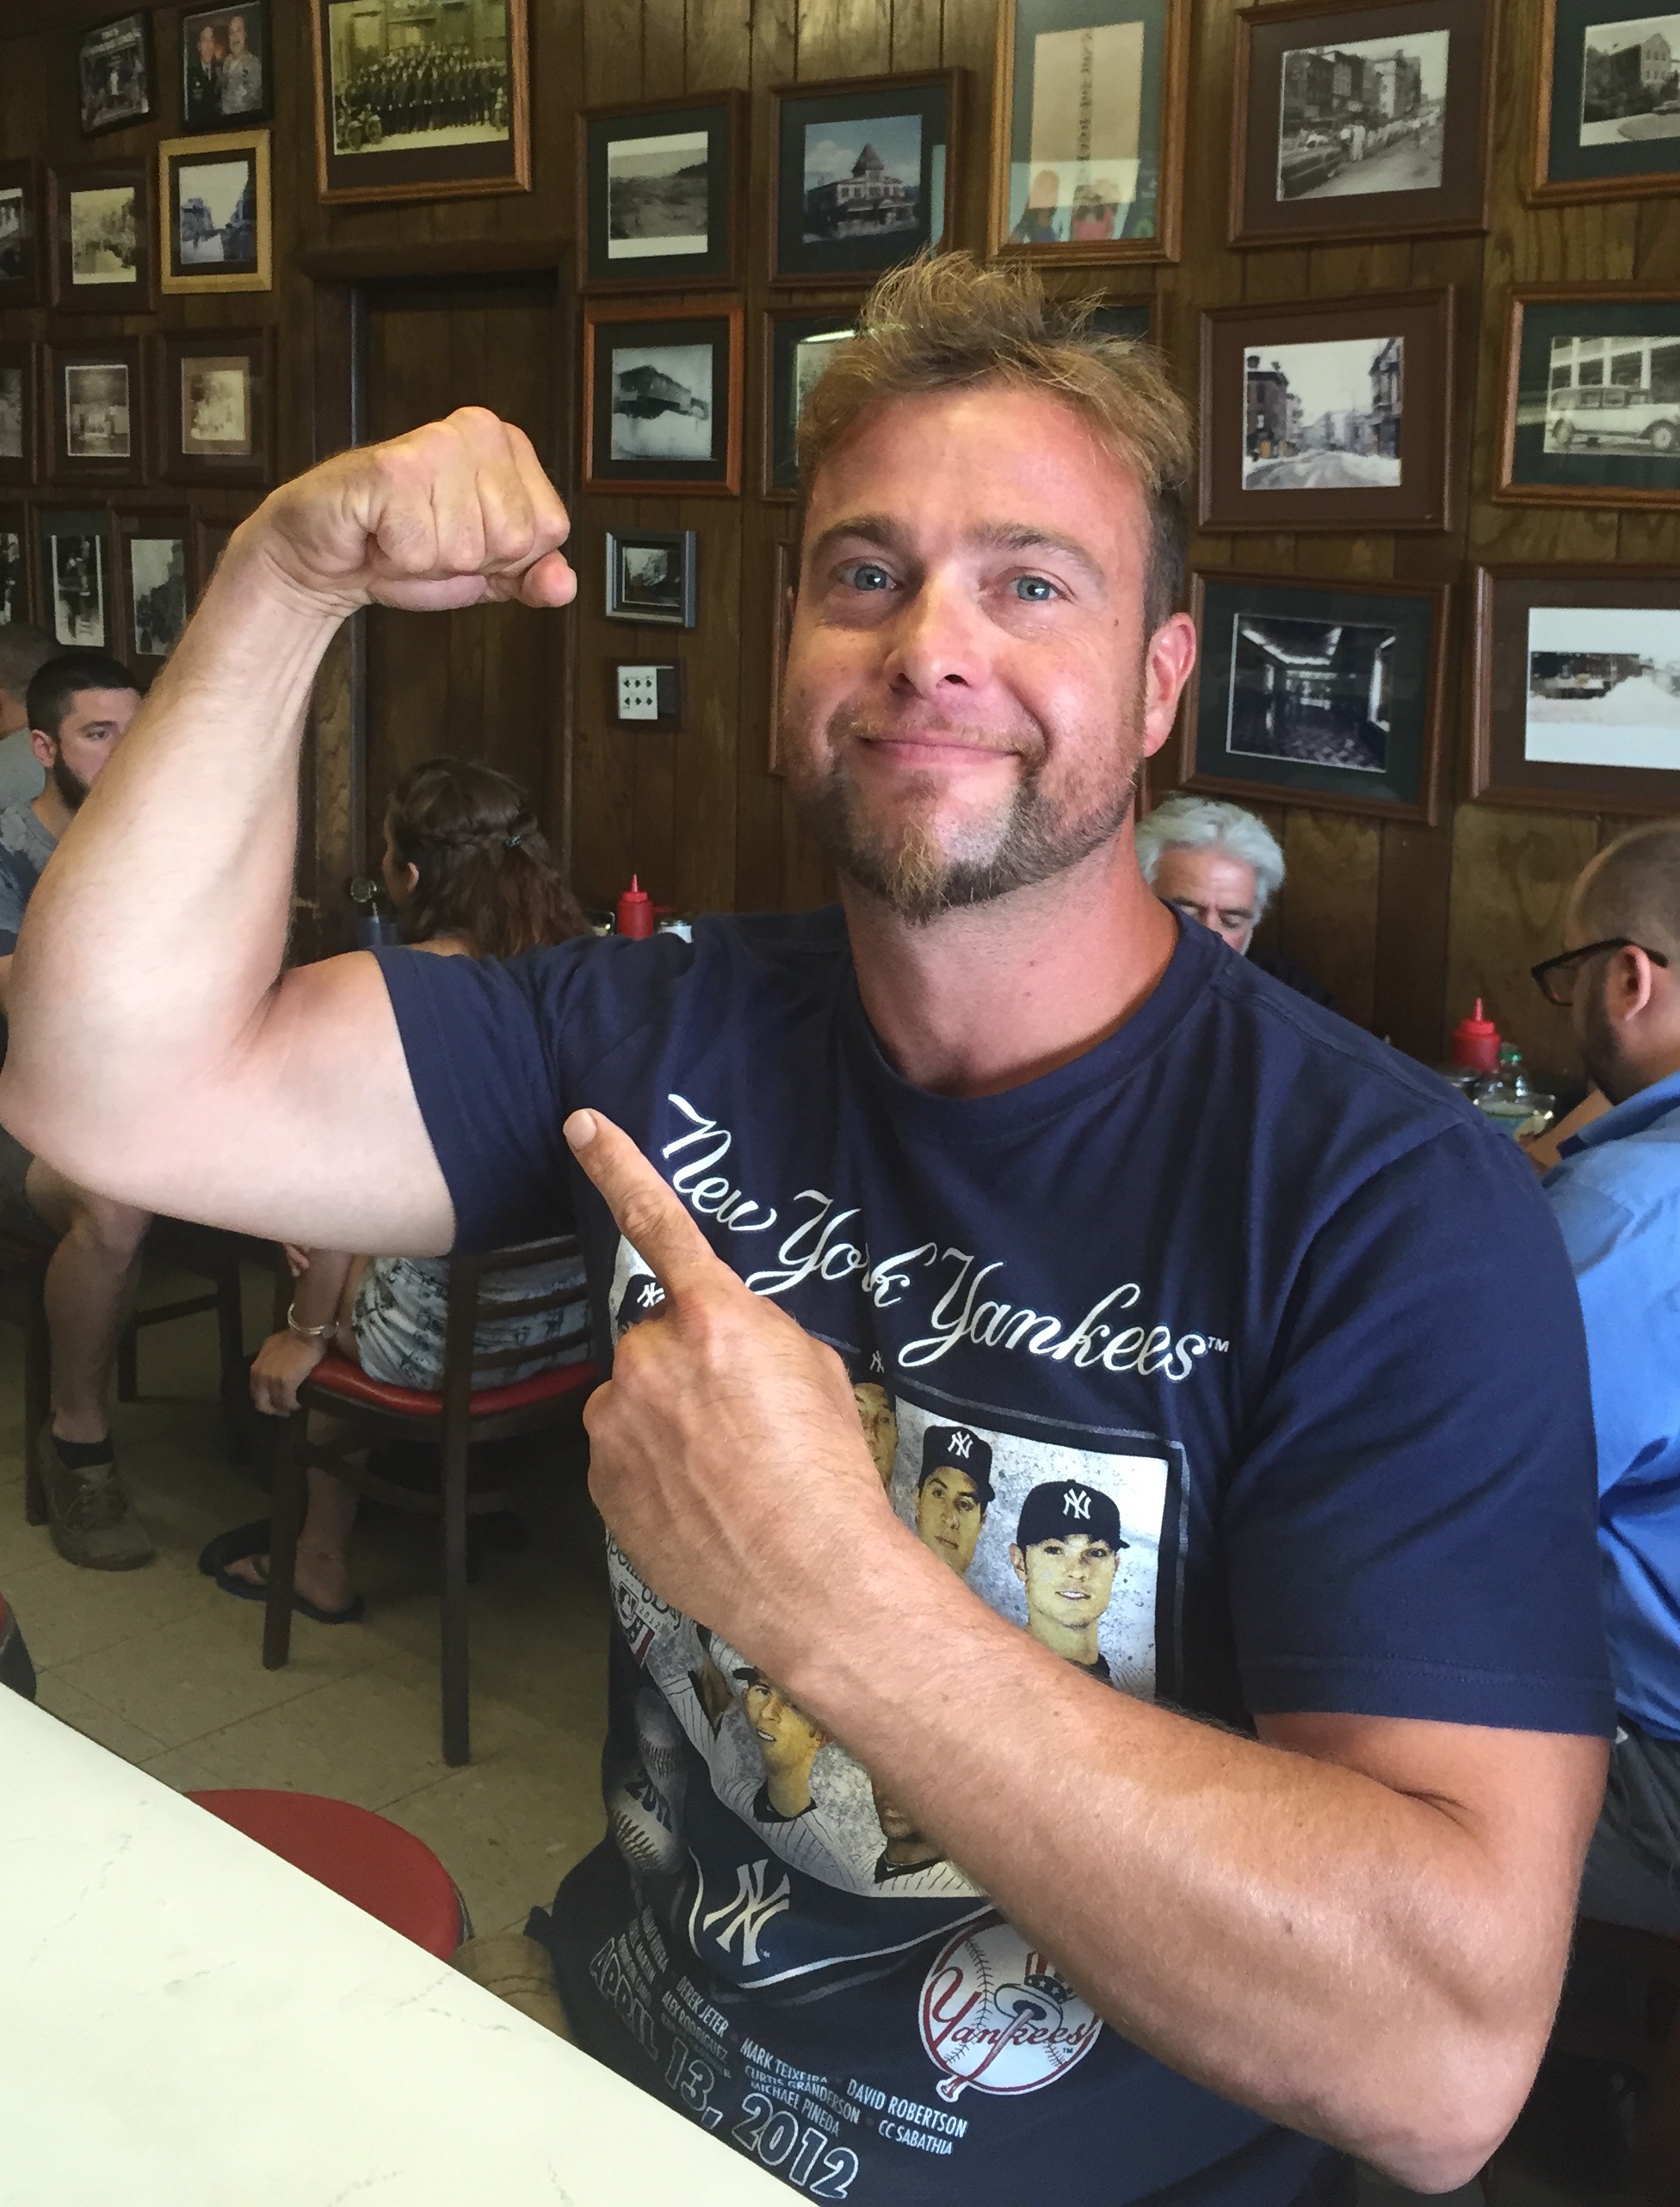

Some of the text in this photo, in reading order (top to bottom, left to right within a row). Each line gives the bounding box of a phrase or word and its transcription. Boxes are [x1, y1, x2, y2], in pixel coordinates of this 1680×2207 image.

[662, 1093, 778, 1231] New
[744, 1189, 938, 1308] York
[898, 1242, 1207, 1382] Yankees
[1062, 1487, 1092, 1520] NY
[702, 1858, 791, 1967] NY
[676, 1975, 704, 2014] DEREK
[698, 2004, 730, 2039] JETER
[740, 2037, 775, 2071] MARK
[775, 2058, 828, 2083] TEIXEIRA
[846, 2078, 887, 2111] DAVID
[887, 2095, 969, 2139] ROBERTSON
[924, 1966, 1092, 2050] Yankees
[661, 1989, 682, 2024] ALEX
[744, 2065, 784, 2086] CURTIS
[788, 2080, 861, 2124] GRANDERSON
[878, 2118, 895, 2140] CC
[895, 2128, 954, 2155] SABATHIA
[750, 2081, 840, 2137] MICHAEL PINEDA
[732, 2092, 859, 2199] 2012
